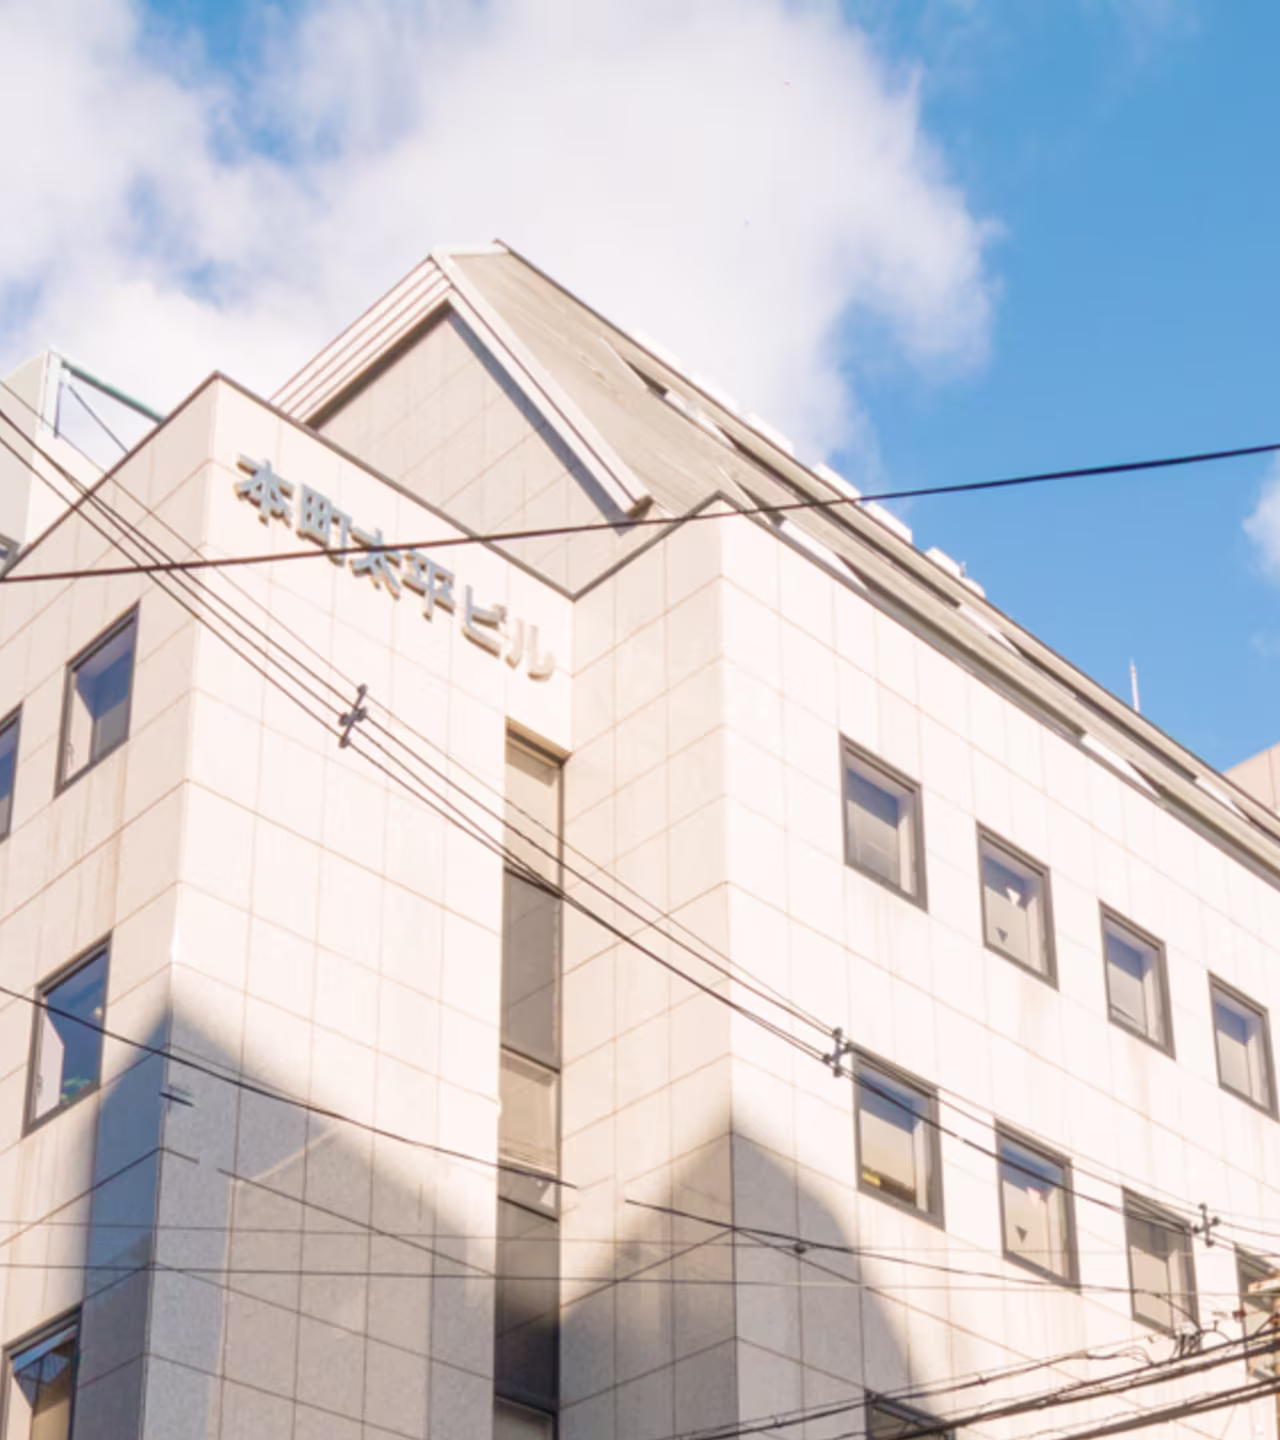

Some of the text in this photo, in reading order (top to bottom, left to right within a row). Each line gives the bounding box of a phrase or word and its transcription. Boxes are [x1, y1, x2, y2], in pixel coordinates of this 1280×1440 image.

[234, 453, 557, 682] 本町太平ビル
